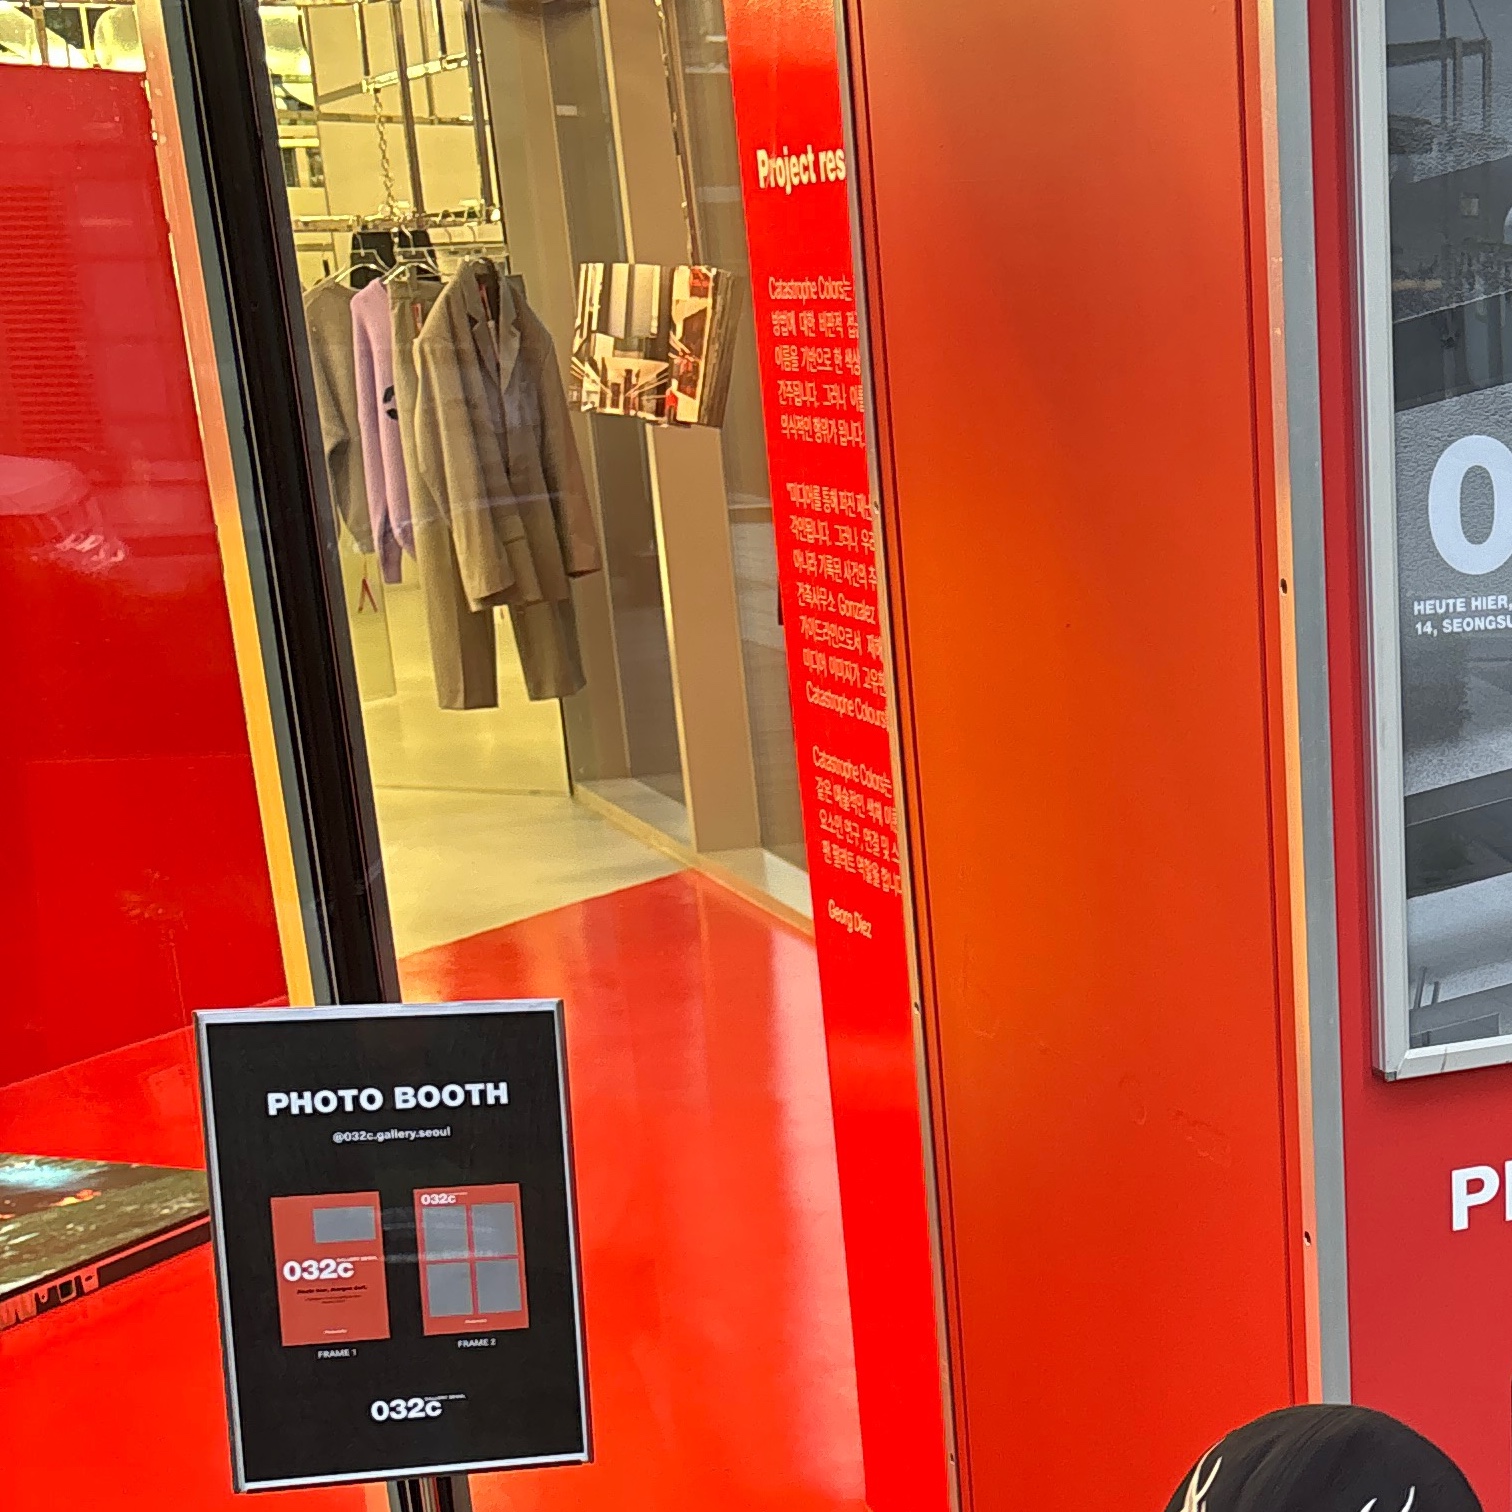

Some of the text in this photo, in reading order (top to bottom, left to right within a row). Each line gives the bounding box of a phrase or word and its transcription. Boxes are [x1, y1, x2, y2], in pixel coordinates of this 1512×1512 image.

[756, 145, 817, 195] Project
[768, 276, 817, 305] Catastrophe
[799, 310, 815, 337] 대한
[775, 345, 799, 371] 이름을
[822, 384, 846, 410] 그러나
[834, 524, 859, 553] 그러나
[1414, 596, 1466, 615] HEUTE
[1470, 592, 1512, 611] HIER,
[1415, 621, 1437, 637] 14,
[806, 681, 855, 718] Catastrophe
[828, 898, 853, 933] Georg
[267, 1082, 508, 1115] PHOTO BOOTH
[333, 1126, 451, 1143] @032c.gallery.seoul
[421, 1193, 456, 1205] 032c
[283, 1259, 354, 1281] 032c
[318, 1349, 350, 1358] FRAME
[458, 1339, 489, 1348] FRAME
[371, 1398, 442, 1421] 032c
